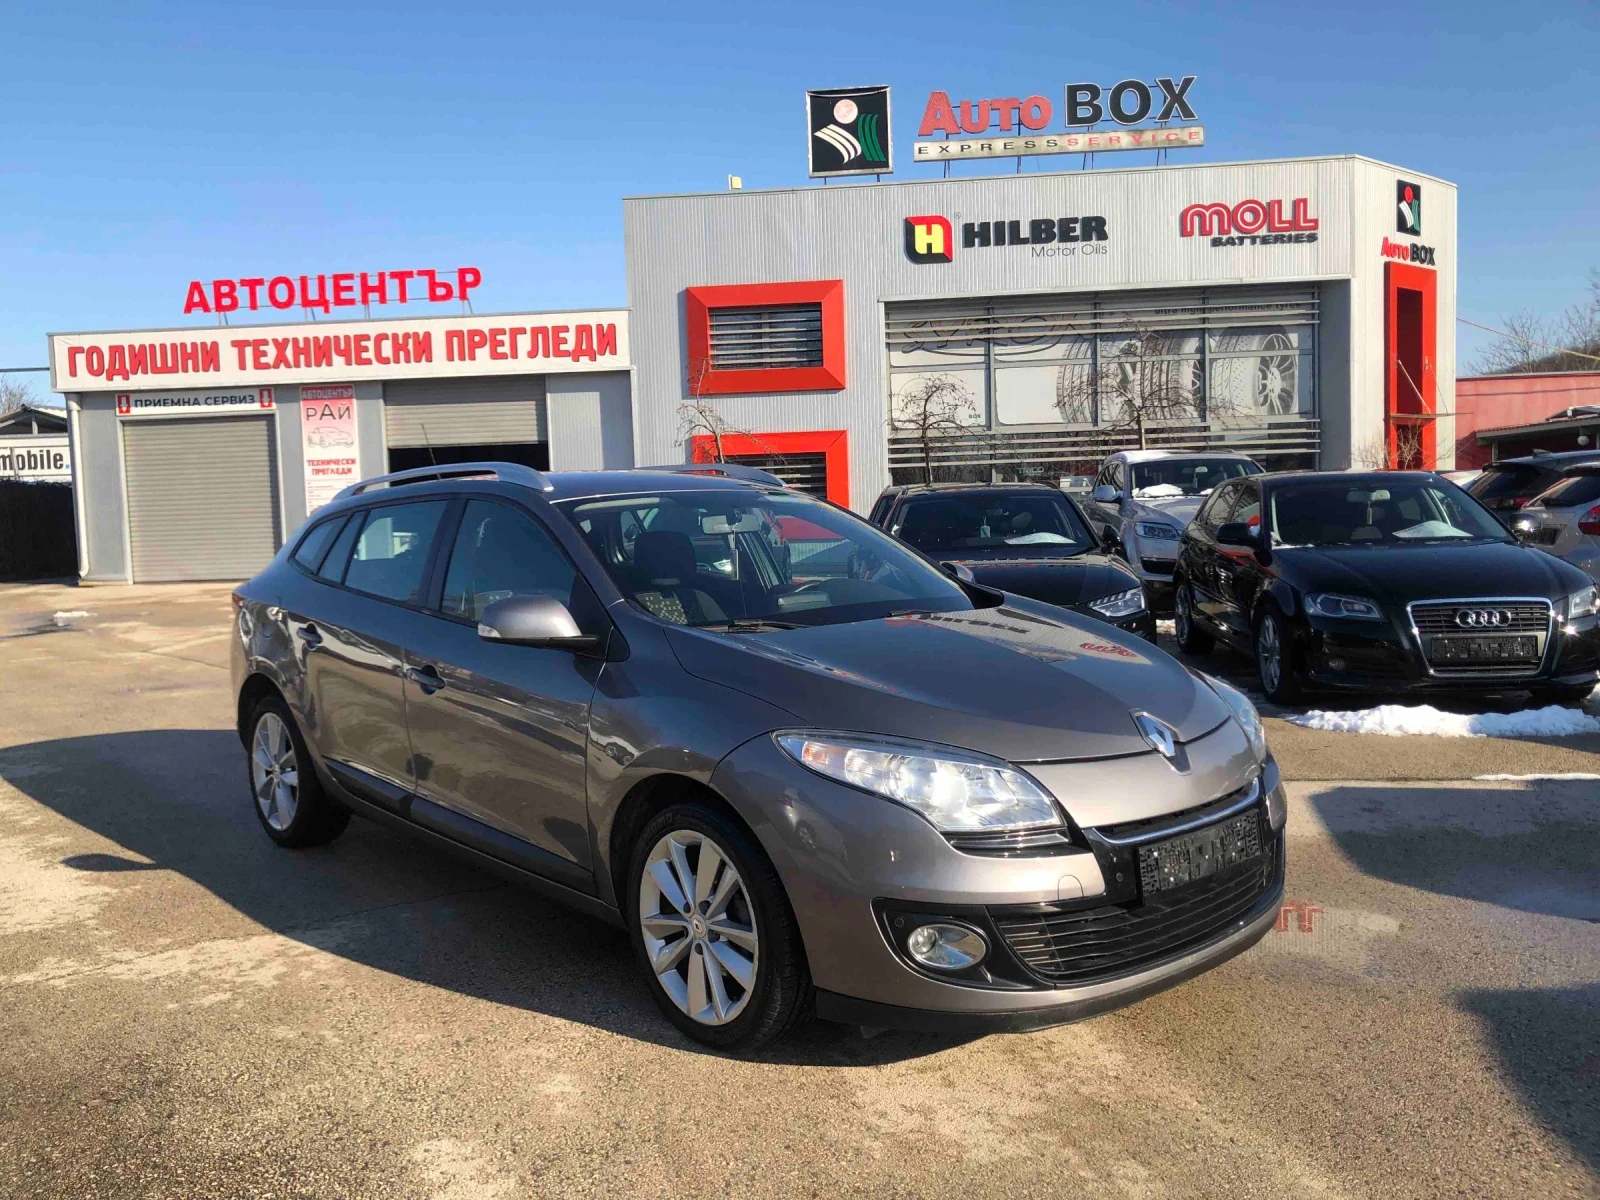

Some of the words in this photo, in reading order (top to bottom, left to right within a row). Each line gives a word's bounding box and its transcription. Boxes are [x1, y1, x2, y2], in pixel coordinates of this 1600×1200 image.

[1064, 75, 1199, 127] BOX
[962, 215, 1109, 248] HILBER
[1211, 232, 1319, 247] BATTERIES
[1031, 246, 1076, 258] Motor
[1081, 244, 1108, 255] Oils
[183, 267, 481, 313] АВТОЦЕНТЪР
[68, 340, 220, 381] ГОДИШНИ
[231, 331, 432, 370] ТЕХНИЧЕСКИ
[445, 323, 617, 362] ПРЕГЛЕДИ
[134, 397, 201, 408] ПРИЕМНА
[204, 394, 256, 406] СЕРВИЗ
[302, 389, 354, 399] АВТОЦЕНТЪР
[306, 403, 351, 421] РАЙ
